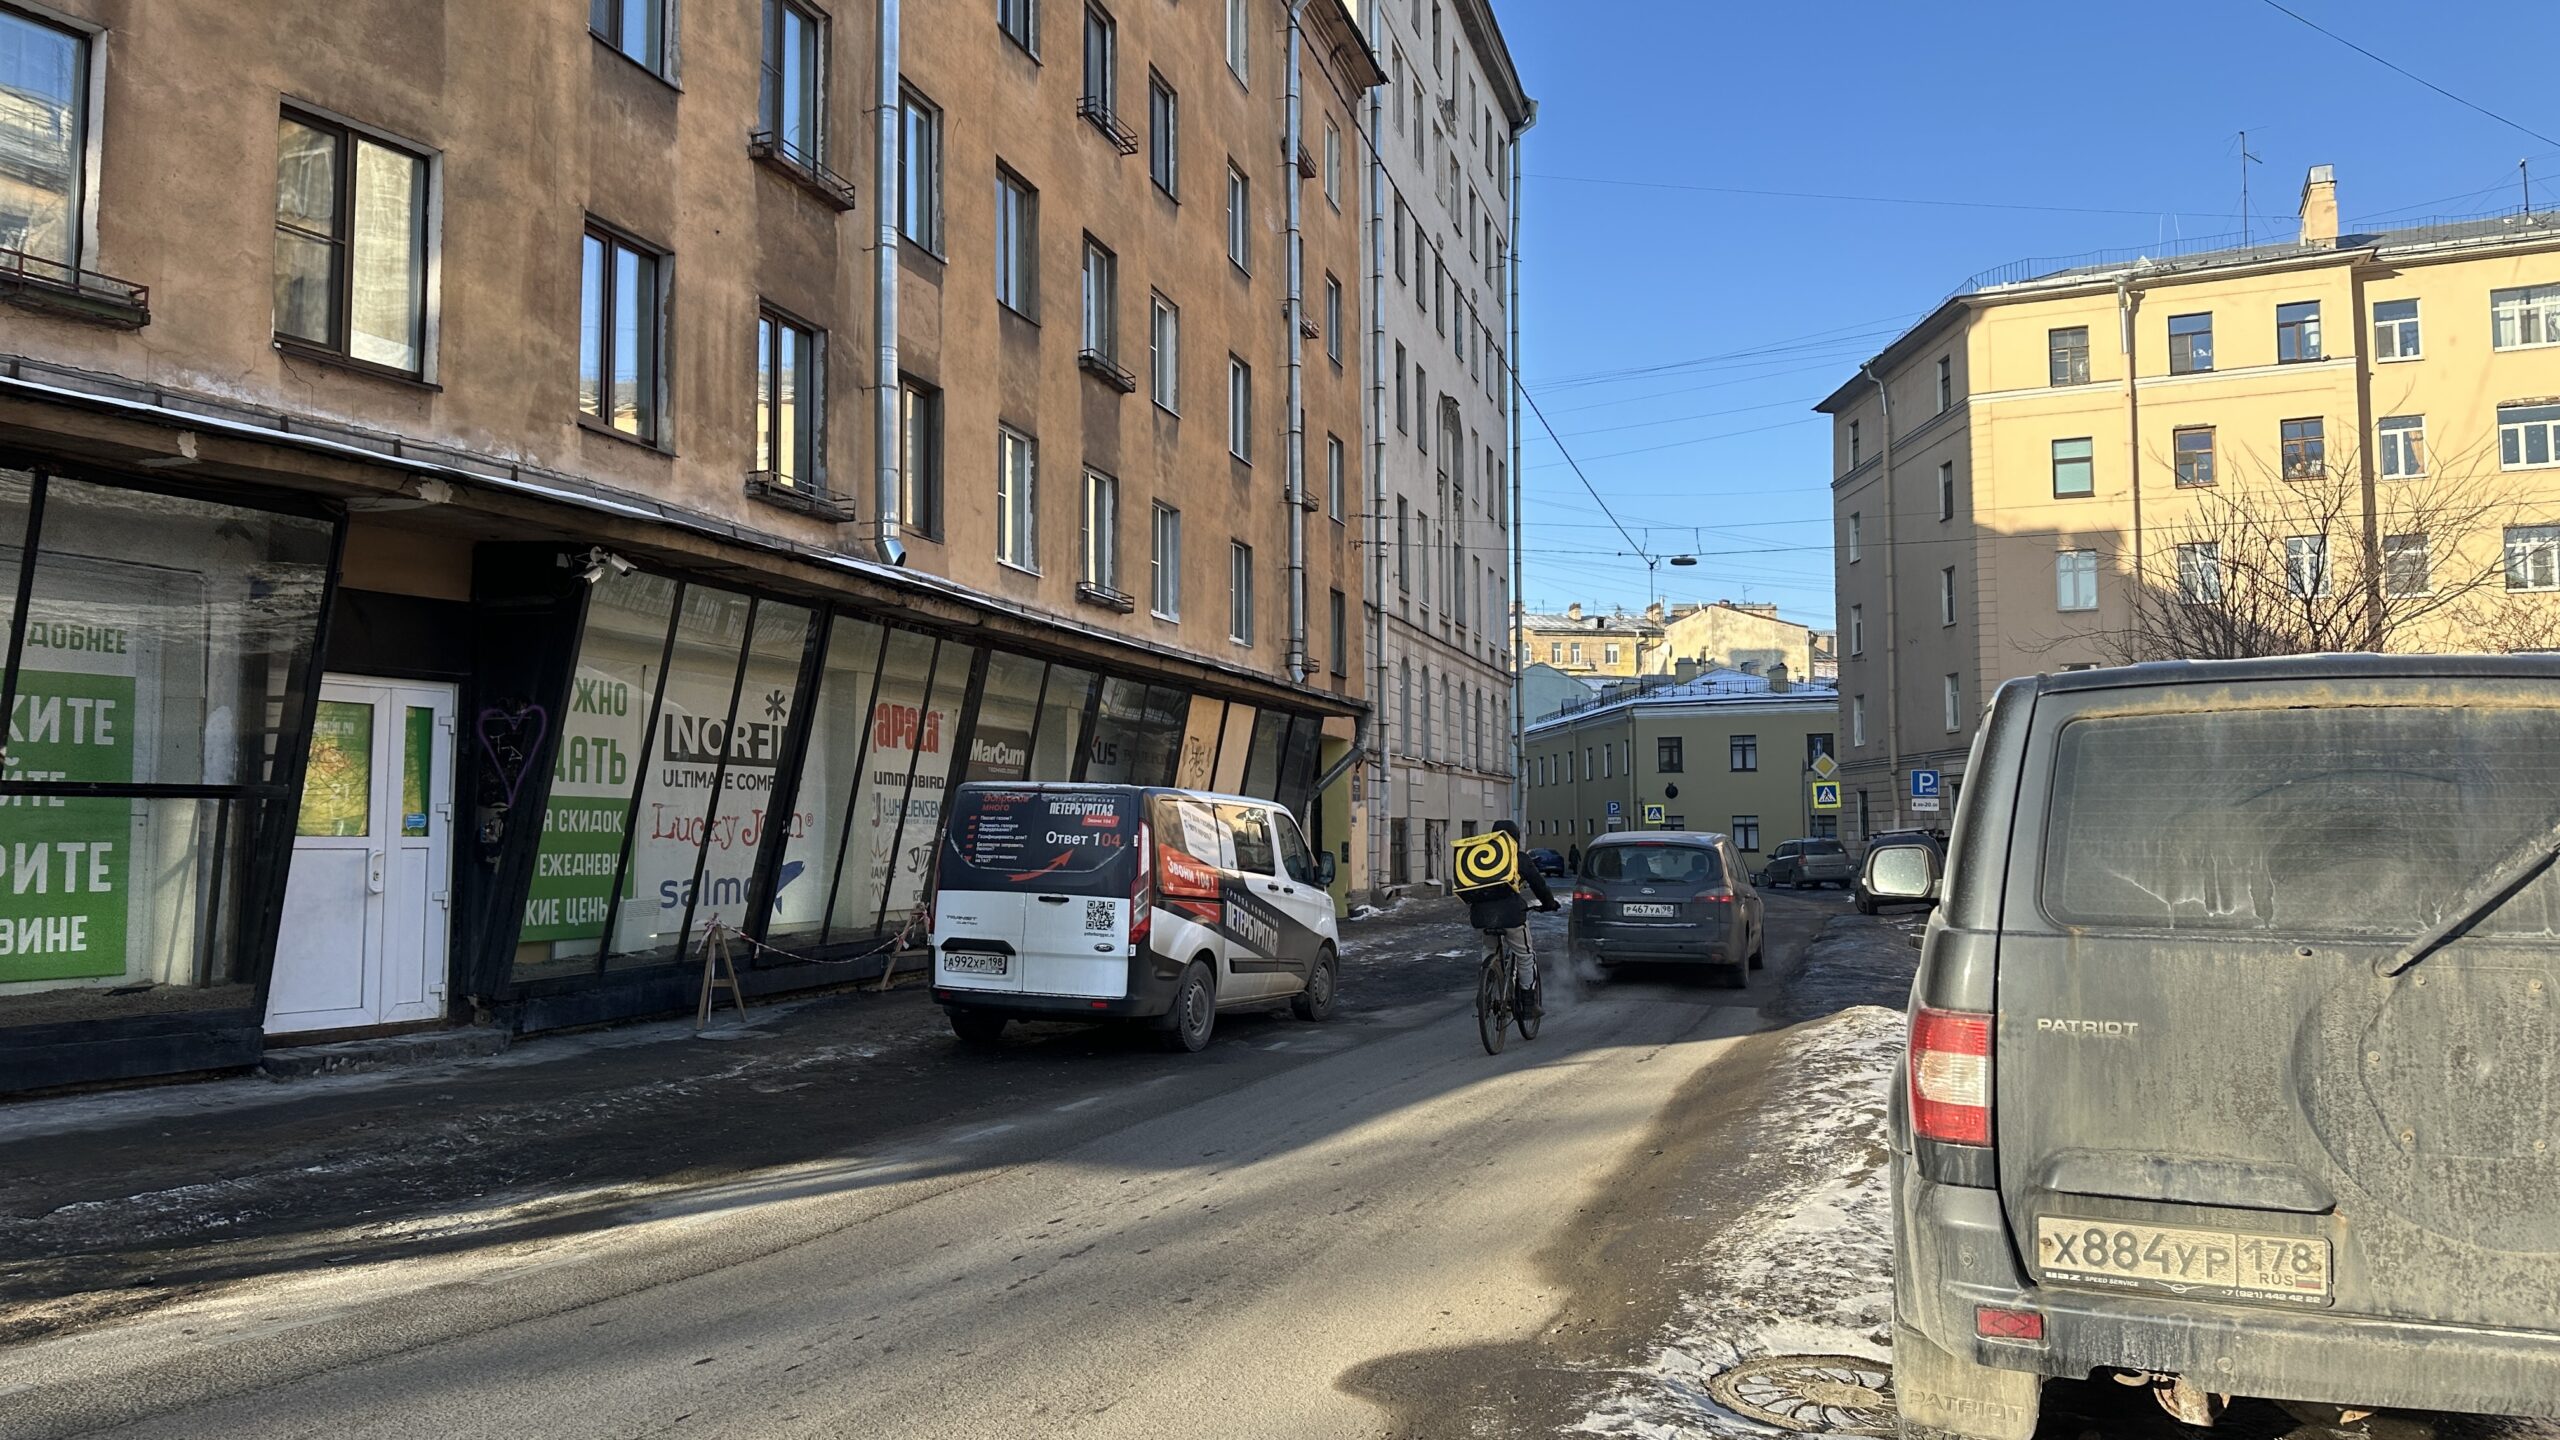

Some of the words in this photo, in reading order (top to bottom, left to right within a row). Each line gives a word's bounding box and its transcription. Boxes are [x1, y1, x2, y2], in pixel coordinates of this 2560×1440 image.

[7, 620, 127, 655] ДОБНЕЕ
[670, 713, 784, 762] NORFI
[662, 768, 734, 790] ULTIMAE
[1049, 802, 1114, 817] ПЕТЕРБУРГГАЗ
[1045, 831, 1089, 846] Ответ
[1093, 832, 1121, 848] 104
[0, 842, 113, 895] ИТЕ
[539, 853, 629, 876] ЕЖЕДНЕВН
[1626, 904, 1661, 914] Р467УА
[1226, 900, 1280, 957] ПЕТЕРБУРГГАЗ
[2037, 1018, 2139, 1035] PATRIOT
[2053, 1228, 2230, 1279] Х884УР
[2241, 1239, 2313, 1275] 178
[2084, 1276, 2108, 1284] SPEED
[2109, 1278, 2139, 1288] SERVICE
[2259, 1272, 2294, 1287] RUS
[2264, 1292, 2286, 1301] 442
[2288, 1294, 2303, 1303] 42
[2305, 1296, 2321, 1304] 22
[1908, 1389, 2025, 1423] PATRIOT
